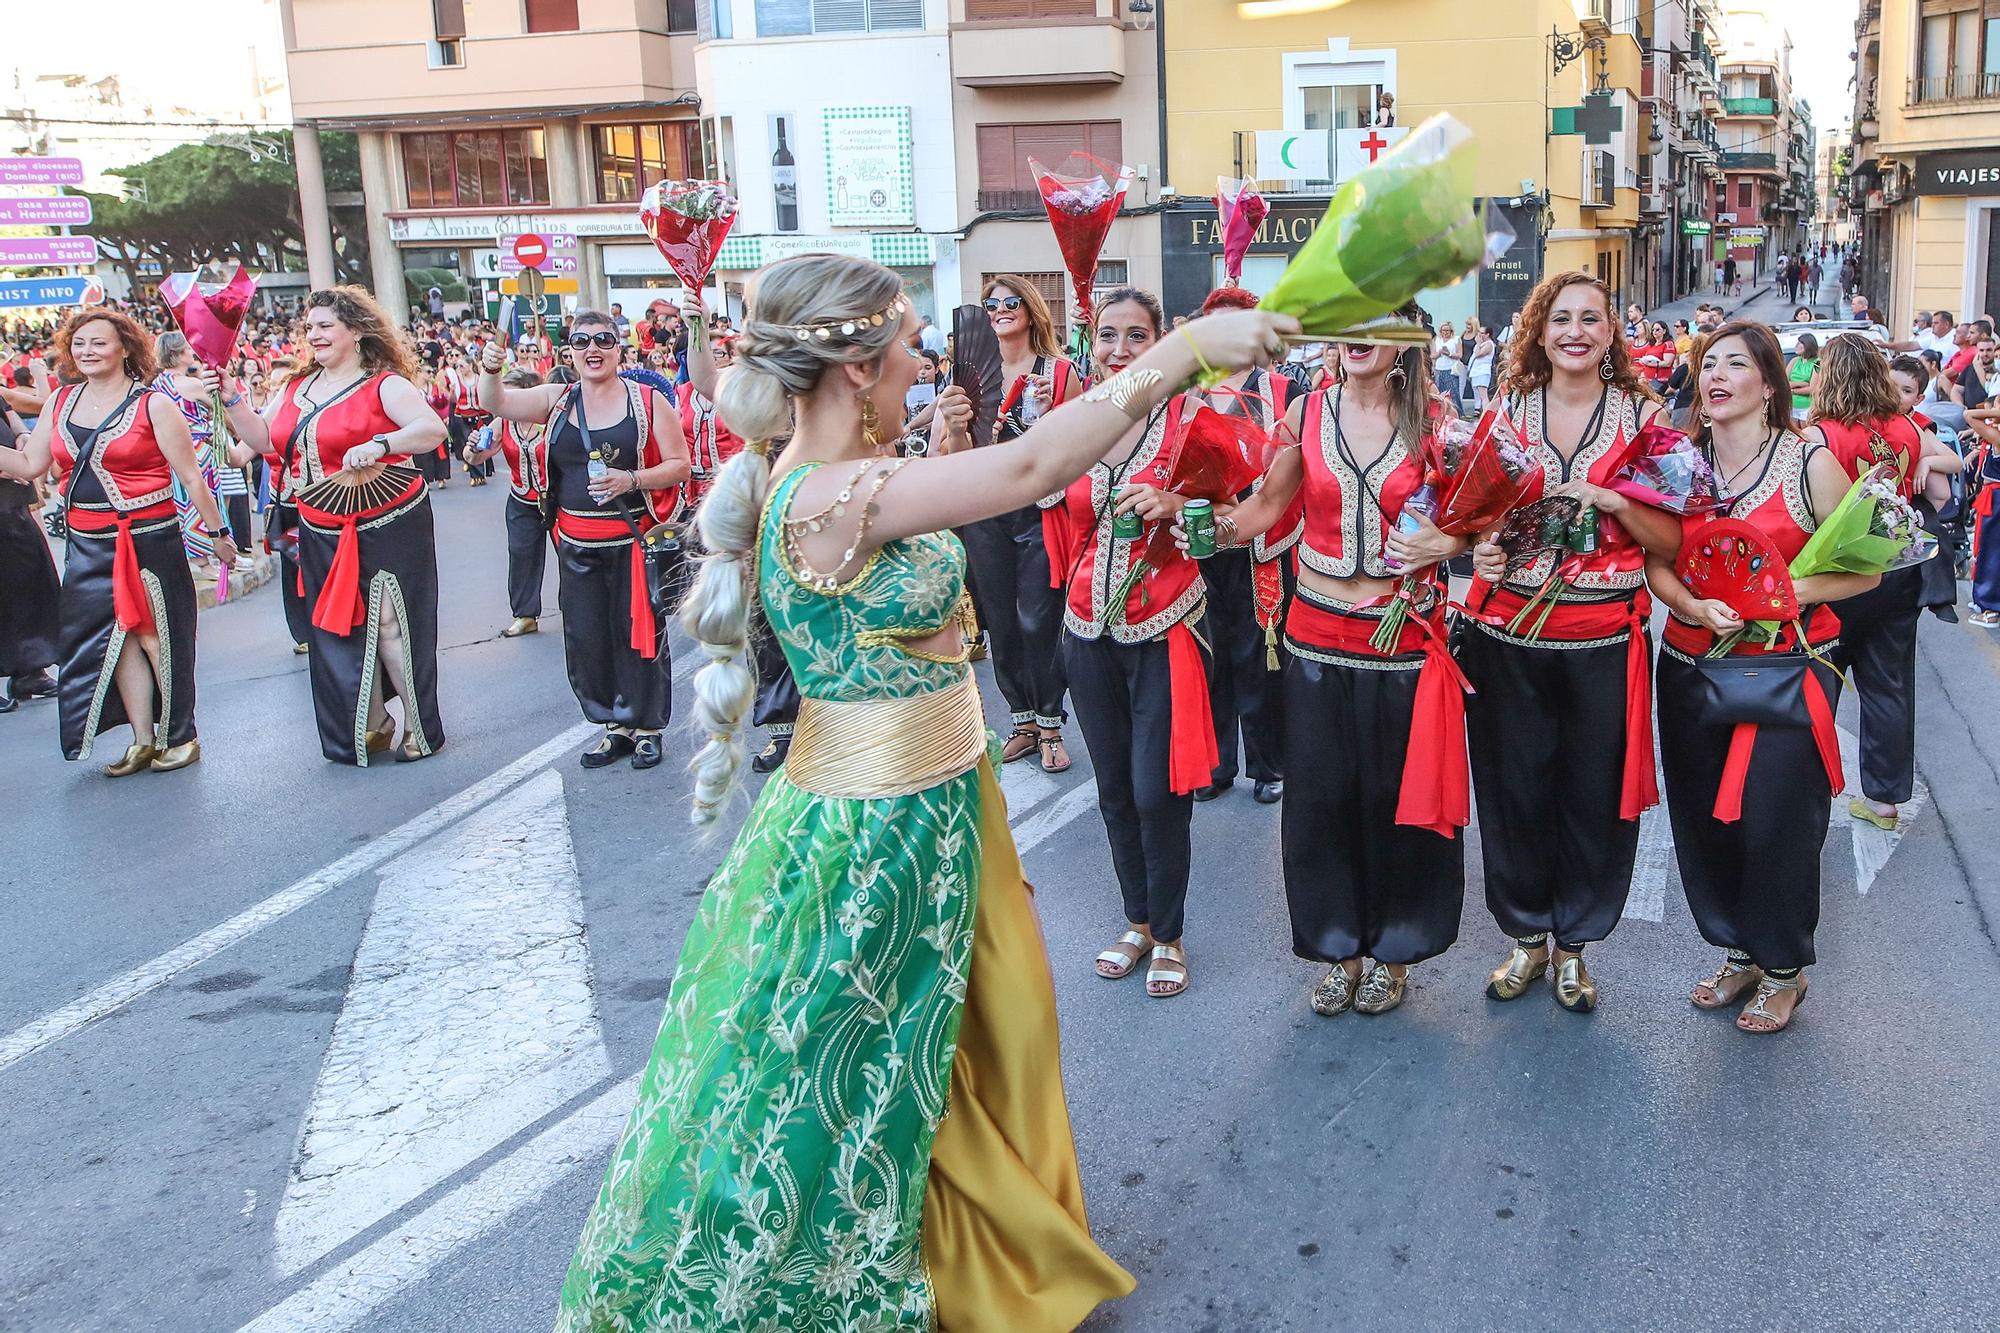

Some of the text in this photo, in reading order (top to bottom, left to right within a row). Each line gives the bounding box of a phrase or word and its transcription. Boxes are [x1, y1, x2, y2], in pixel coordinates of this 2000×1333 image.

[32, 162, 80, 170] diocesano
[4, 172, 81, 181] Domingo (BIC)
[1936, 168, 2000, 186] VIAJES
[48, 201, 84, 209] museo
[18, 208, 86, 220] Hernández
[424, 215, 490, 237] Almira
[514, 214, 568, 234] Hijos
[623, 223, 634, 232] DE
[1191, 217, 1318, 245] FAMACI
[49, 241, 85, 249] museo
[0, 249, 94, 260] Semana Santa
[1488, 260, 1521, 270] Manuel
[1494, 271, 1529, 281] Franco
[40, 286, 74, 299] INFO
